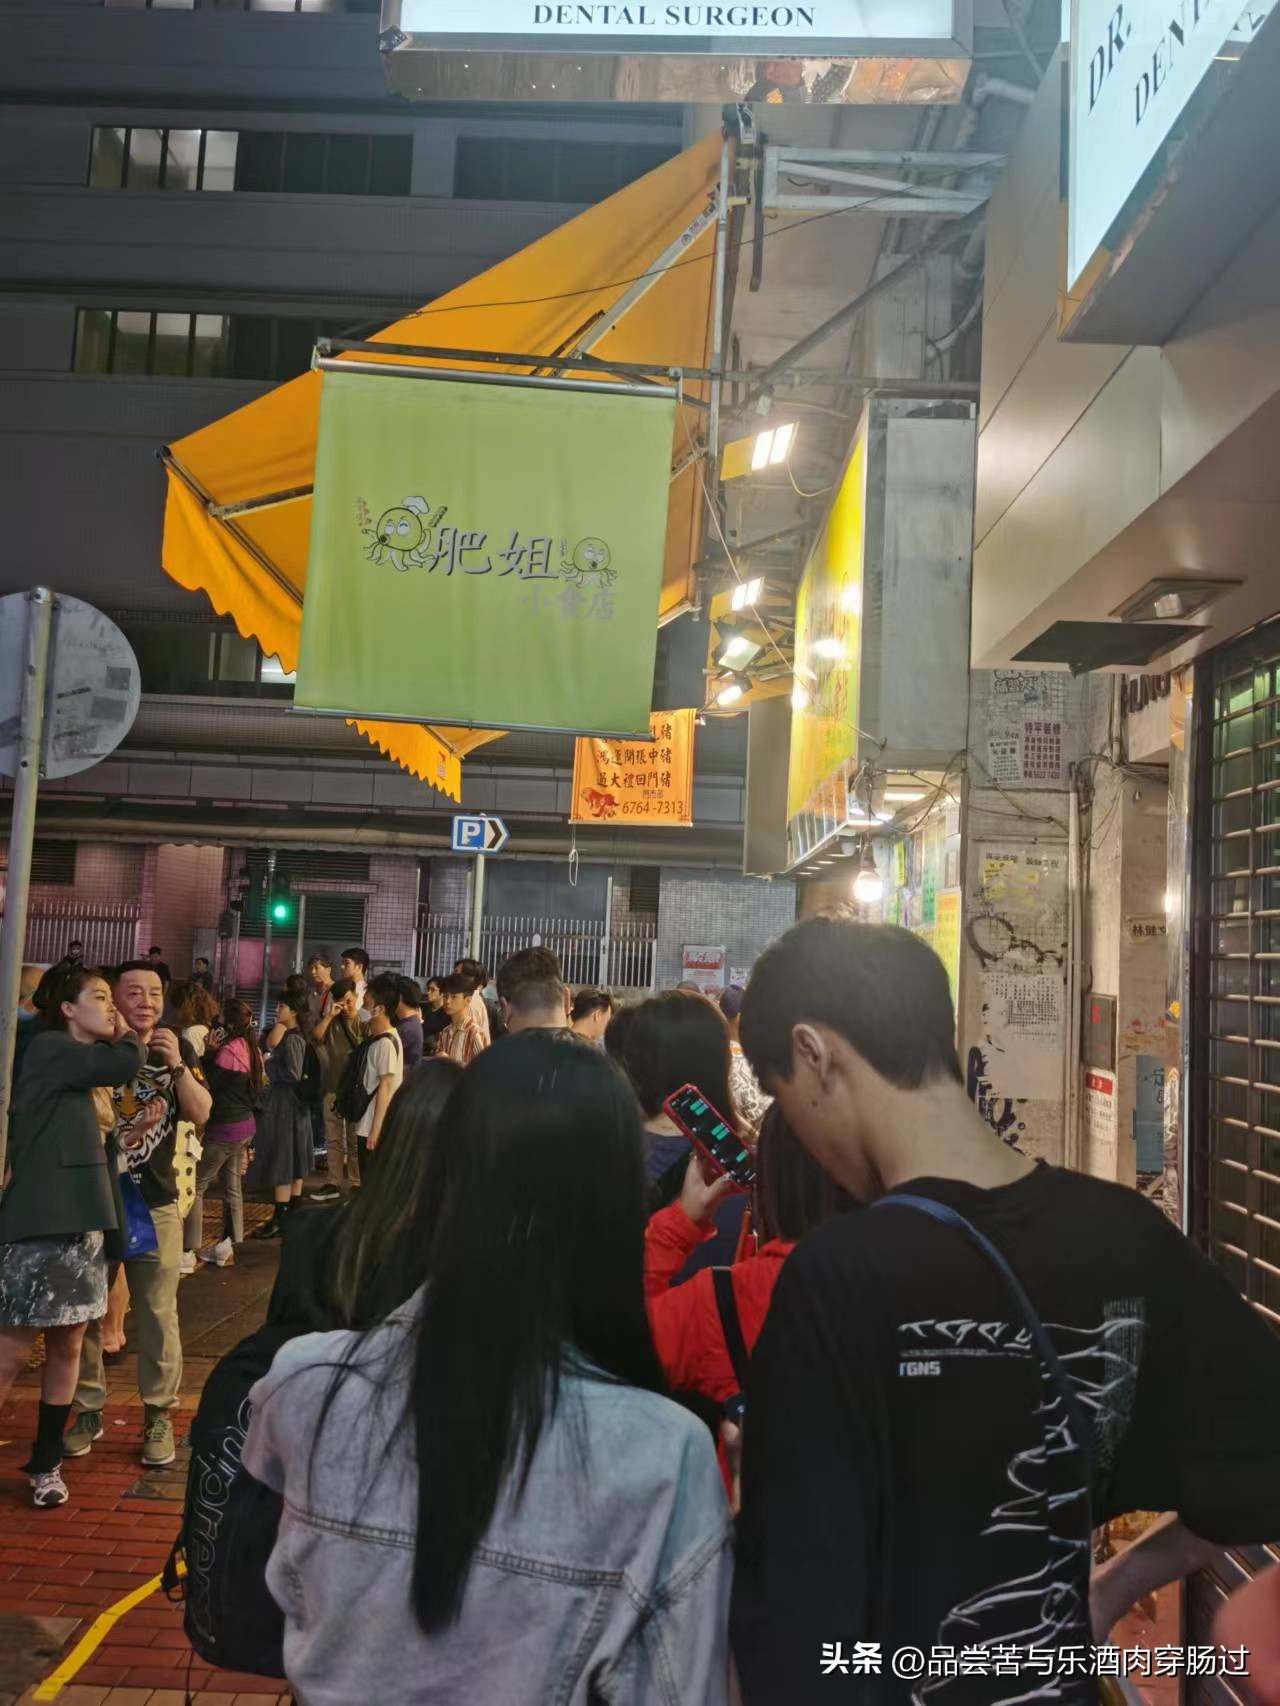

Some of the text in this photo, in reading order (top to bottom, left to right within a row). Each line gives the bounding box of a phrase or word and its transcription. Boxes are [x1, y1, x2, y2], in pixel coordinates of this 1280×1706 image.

[533, 4, 815, 27] DENTAL SURGEON
[428, 528, 559, 580] 肥姐
[520, 586, 616, 621] 小食店
[461, 821, 481, 845] P
